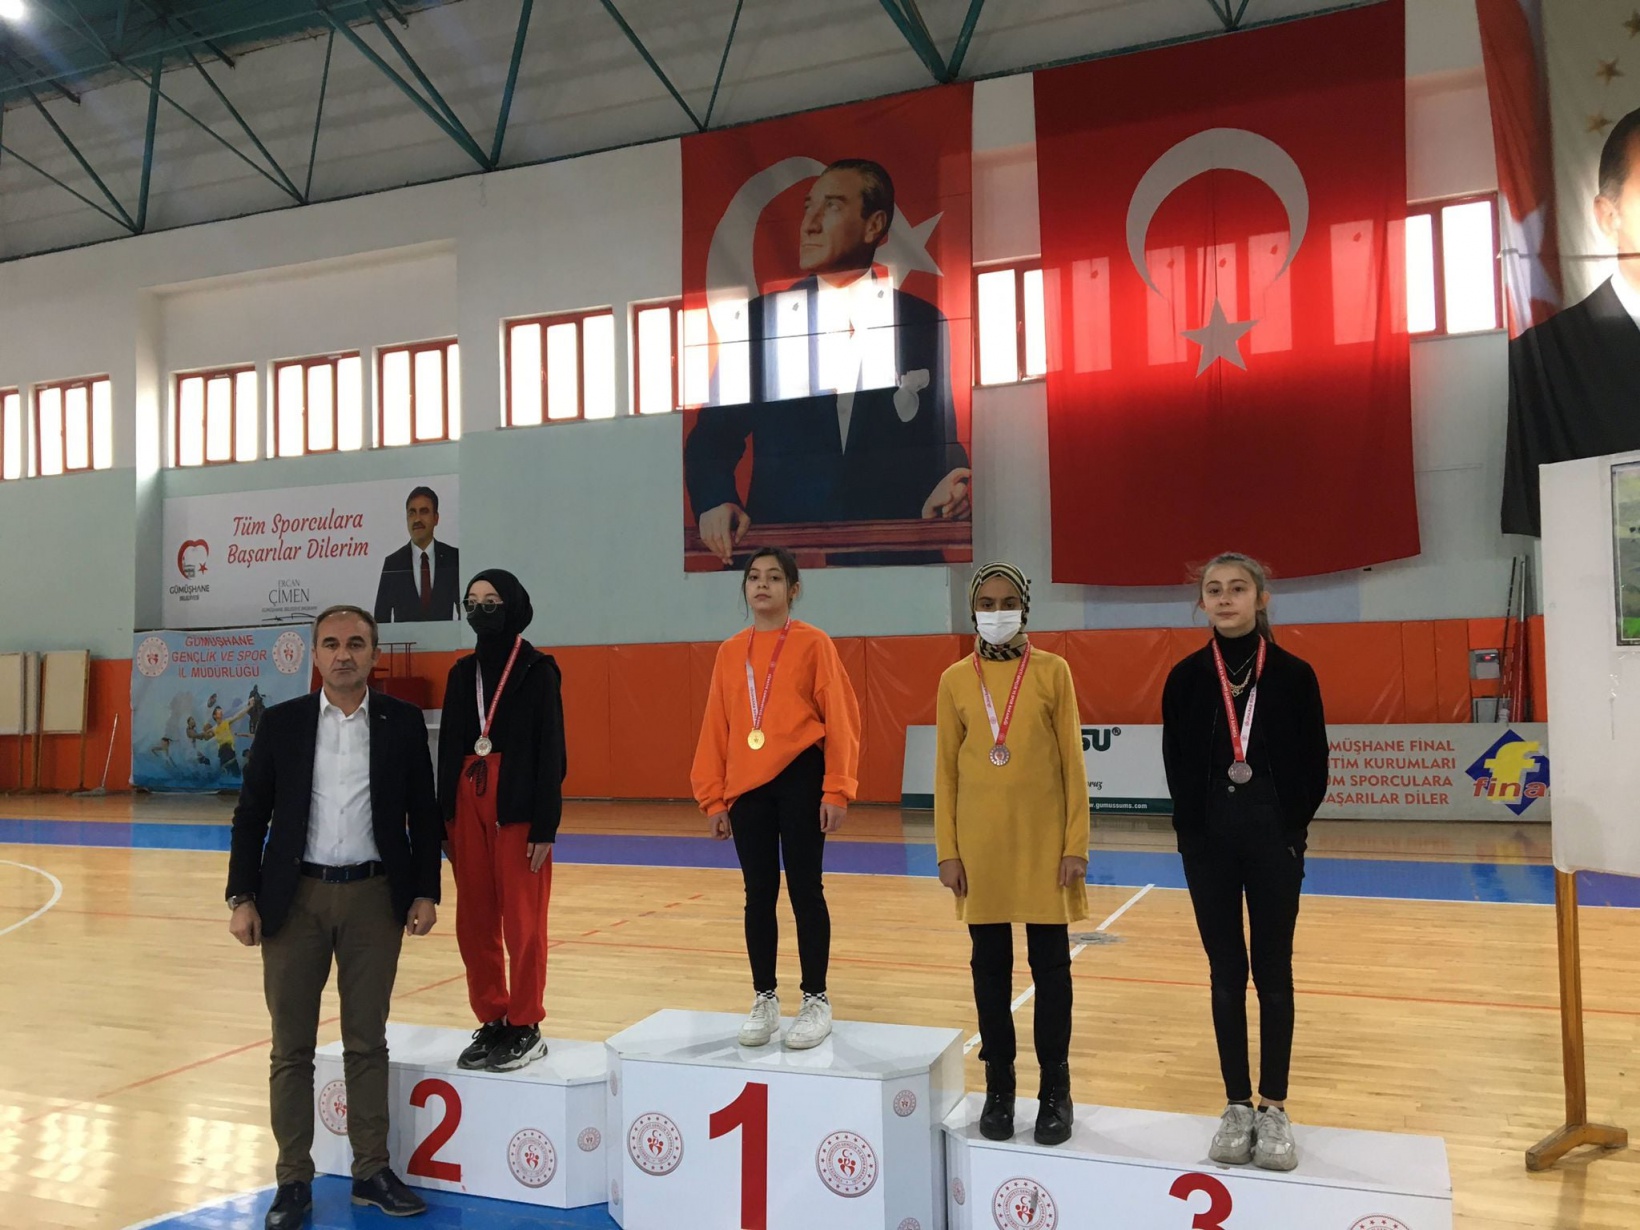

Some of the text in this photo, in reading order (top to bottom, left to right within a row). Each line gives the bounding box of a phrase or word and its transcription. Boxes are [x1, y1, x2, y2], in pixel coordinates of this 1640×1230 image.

[233, 508, 364, 540] Tüm Sporculara
[227, 536, 369, 568] Başarılar Dilerim
[268, 587, 310, 606] ÇİMEN
[172, 649, 267, 664] GENÇLİK VE SPOR
[1410, 737, 1455, 752] FİNAL
[1364, 758, 1456, 769] KURUMLARI
[1350, 775, 1453, 787] SPORCULARA
[1473, 777, 1550, 798] fina
[1321, 790, 1449, 807] AŞARILAR DİLER
[407, 1077, 462, 1183] 2
[709, 1081, 768, 1230] 1
[1168, 1172, 1233, 1230] 3
